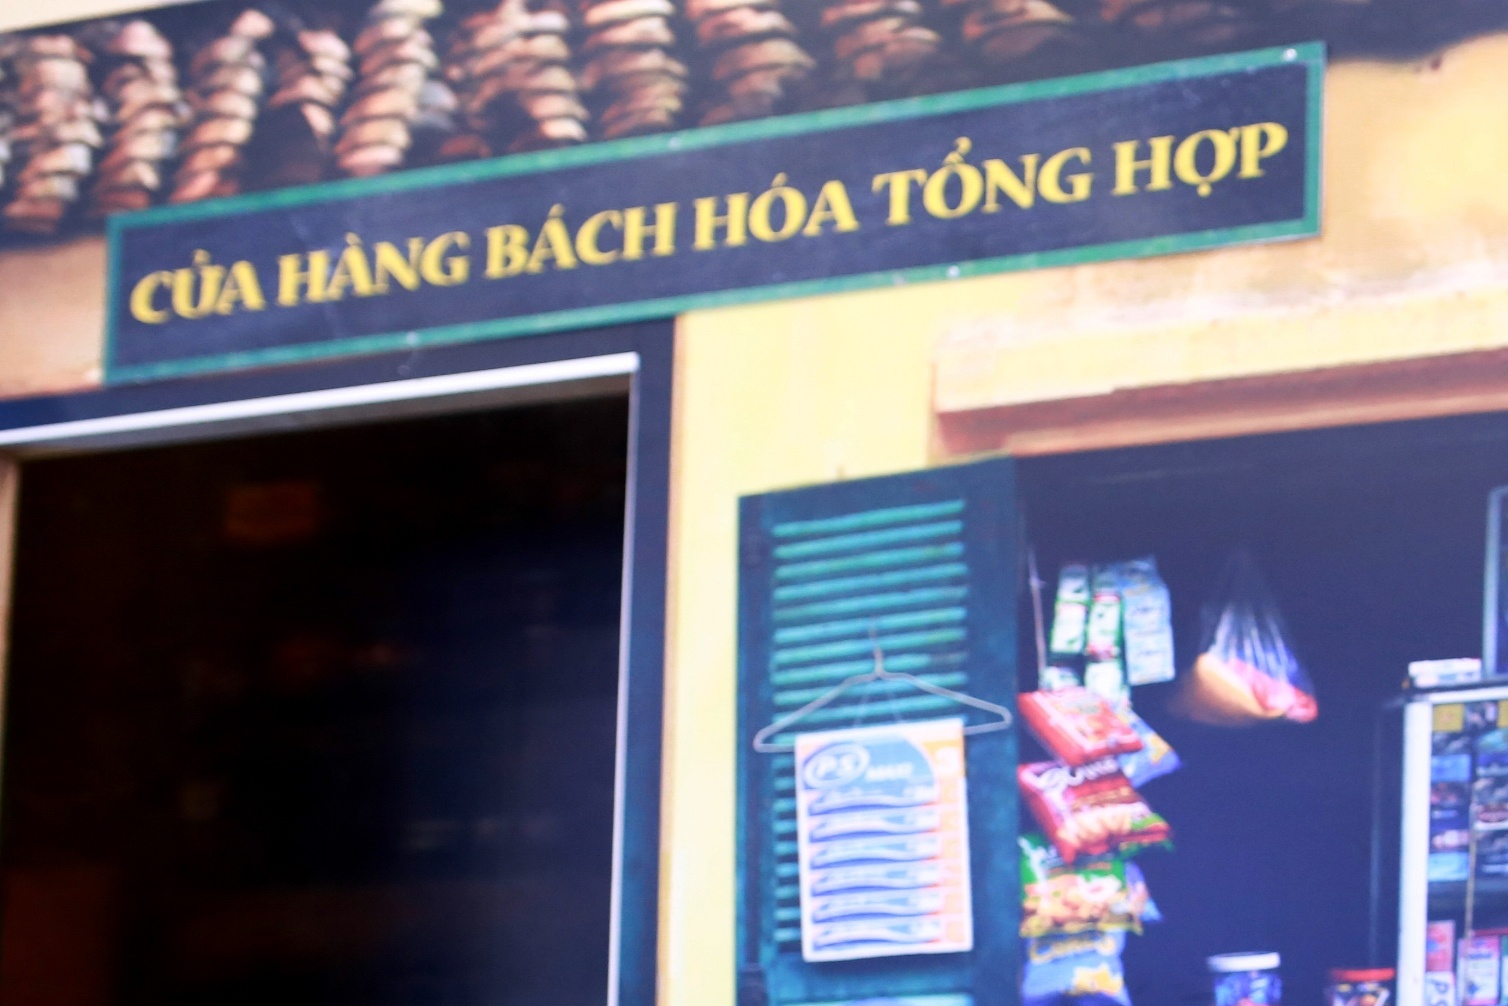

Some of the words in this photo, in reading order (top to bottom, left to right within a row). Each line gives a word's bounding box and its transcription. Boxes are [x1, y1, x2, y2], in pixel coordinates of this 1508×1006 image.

[276, 231, 472, 308] HÀNG
[485, 203, 678, 281] BÁCH
[692, 172, 860, 251] HÓA
[872, 136, 1095, 227] TỔNG
[1111, 121, 1289, 198] HỢP
